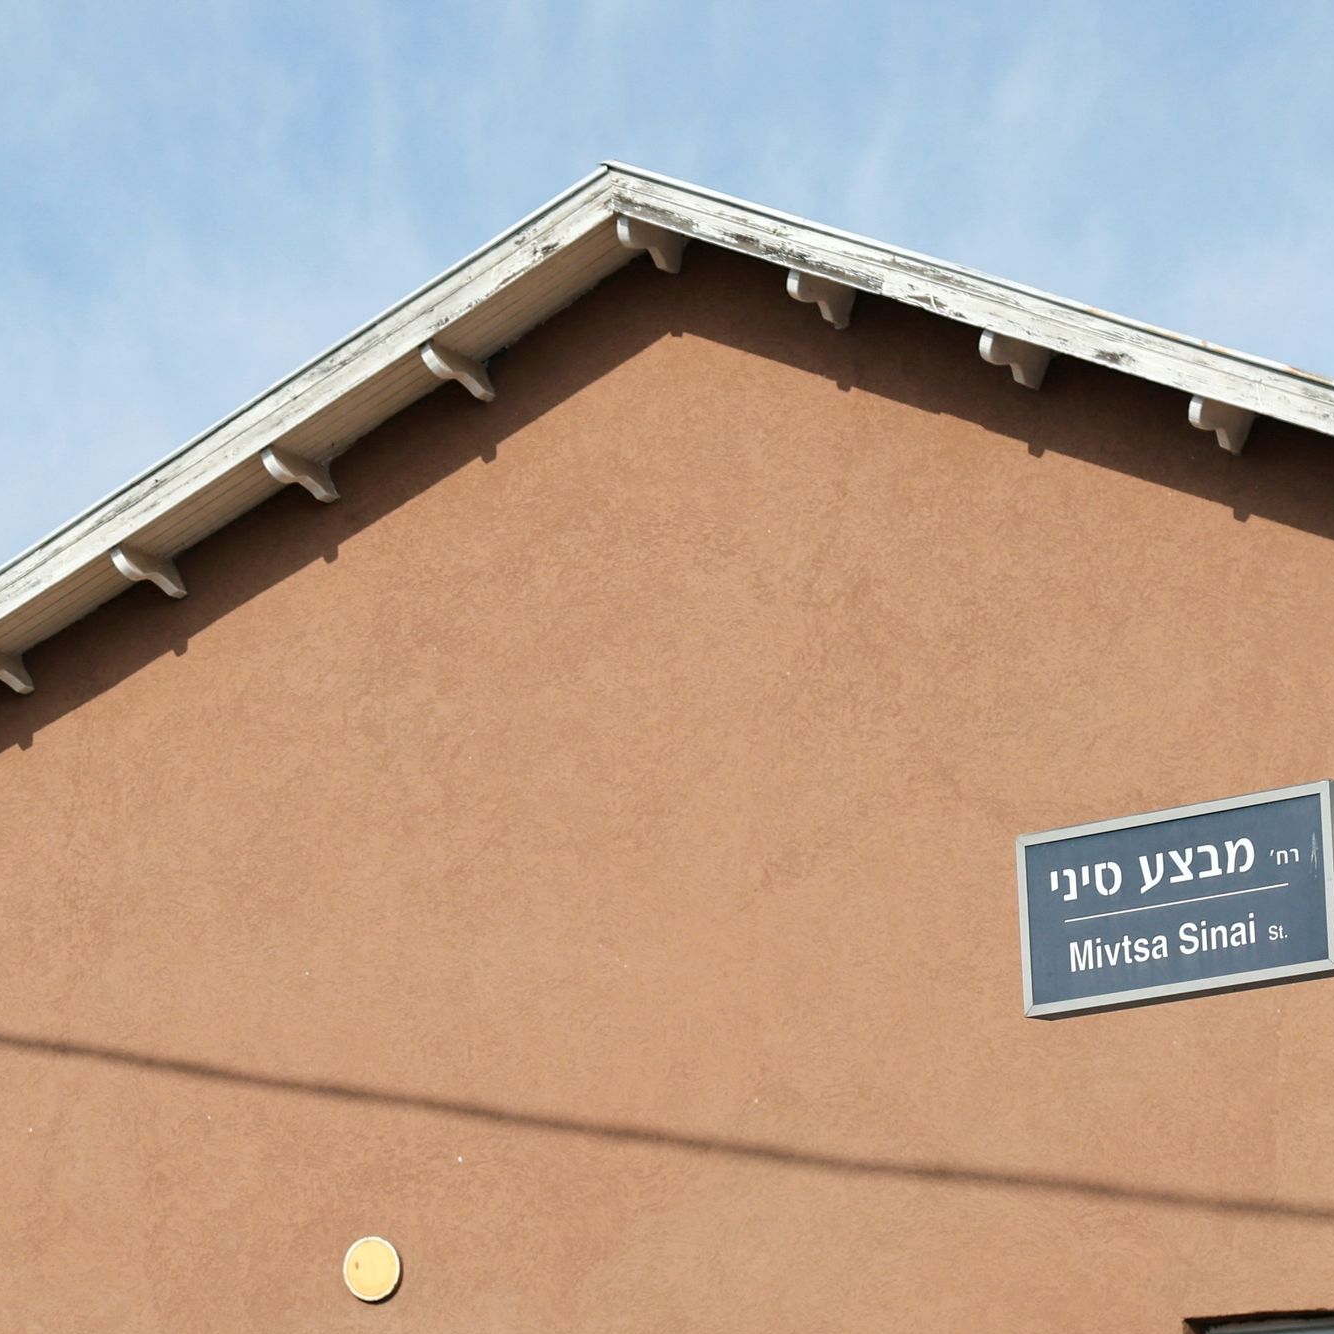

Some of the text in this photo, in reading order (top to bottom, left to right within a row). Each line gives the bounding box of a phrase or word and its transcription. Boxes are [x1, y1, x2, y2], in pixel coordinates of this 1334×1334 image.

[1050, 861, 1123, 902] סיני
[1138, 837, 1256, 894] מבצע
[1069, 912, 1288, 973] Mivtsa Sinai St.
